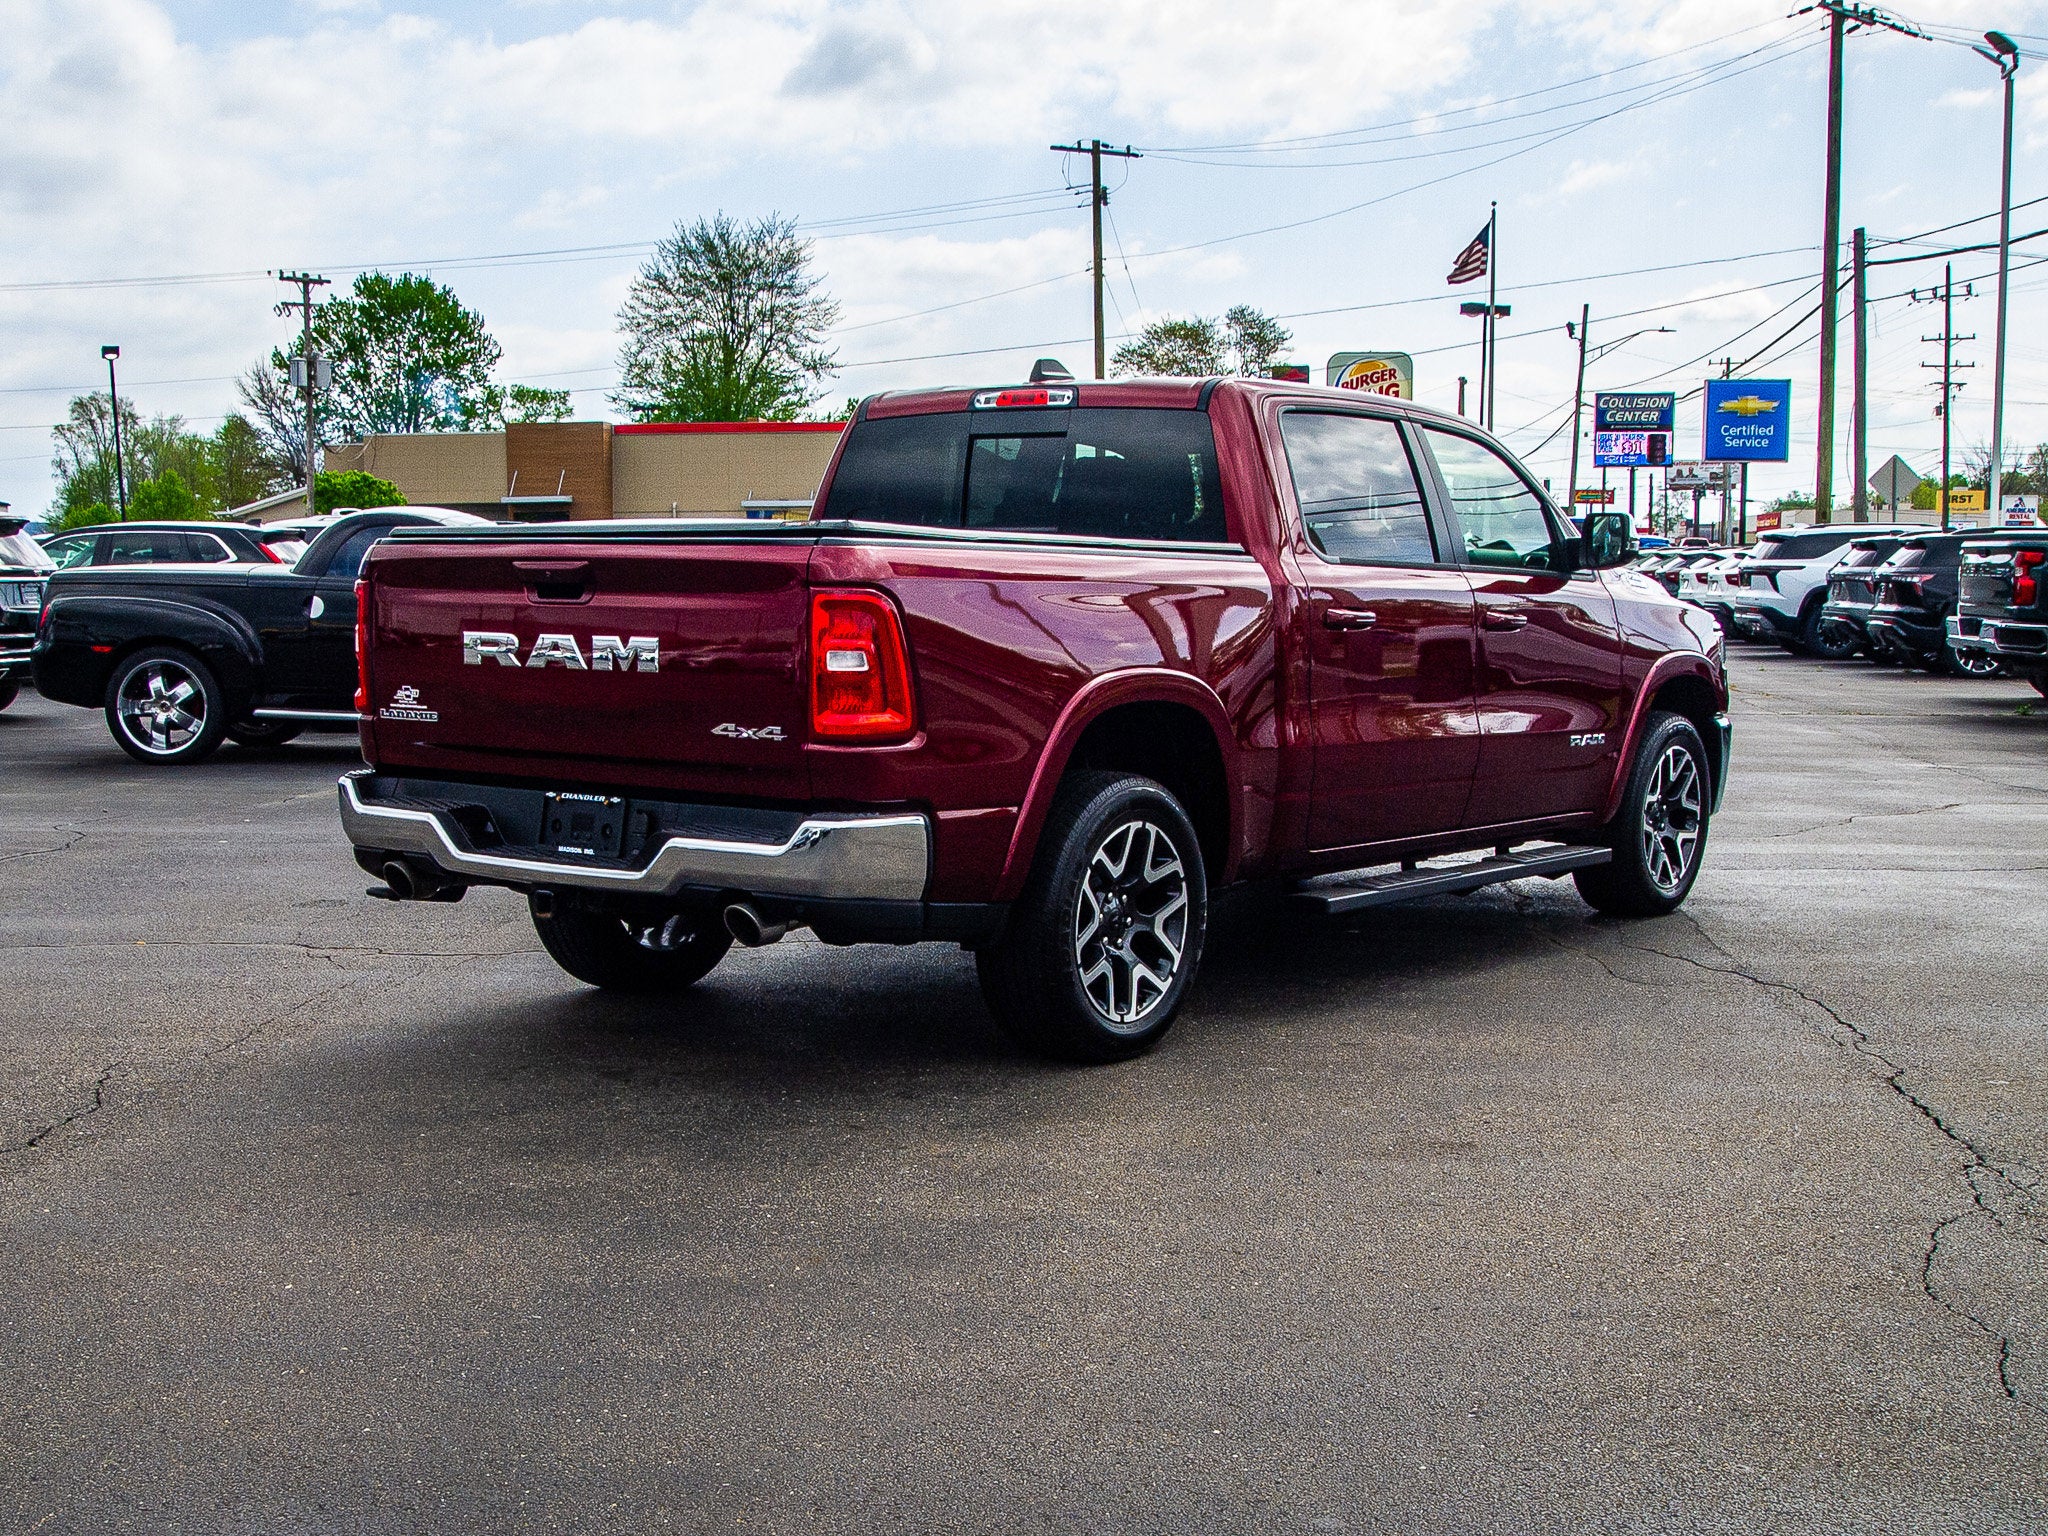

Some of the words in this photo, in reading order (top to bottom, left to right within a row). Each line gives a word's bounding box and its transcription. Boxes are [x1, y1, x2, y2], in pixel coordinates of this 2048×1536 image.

[1341, 368, 1397, 390] BURGER
[1599, 396, 1671, 409] COLLISION
[1606, 410, 1660, 422] CENTER
[1721, 424, 1774, 436] Certified
[1725, 437, 1769, 447] Service
[463, 630, 660, 673] RAM
[380, 708, 439, 722] LARAMIE
[711, 722, 788, 742] 4x4
[561, 792, 606, 802] CHANDLER
